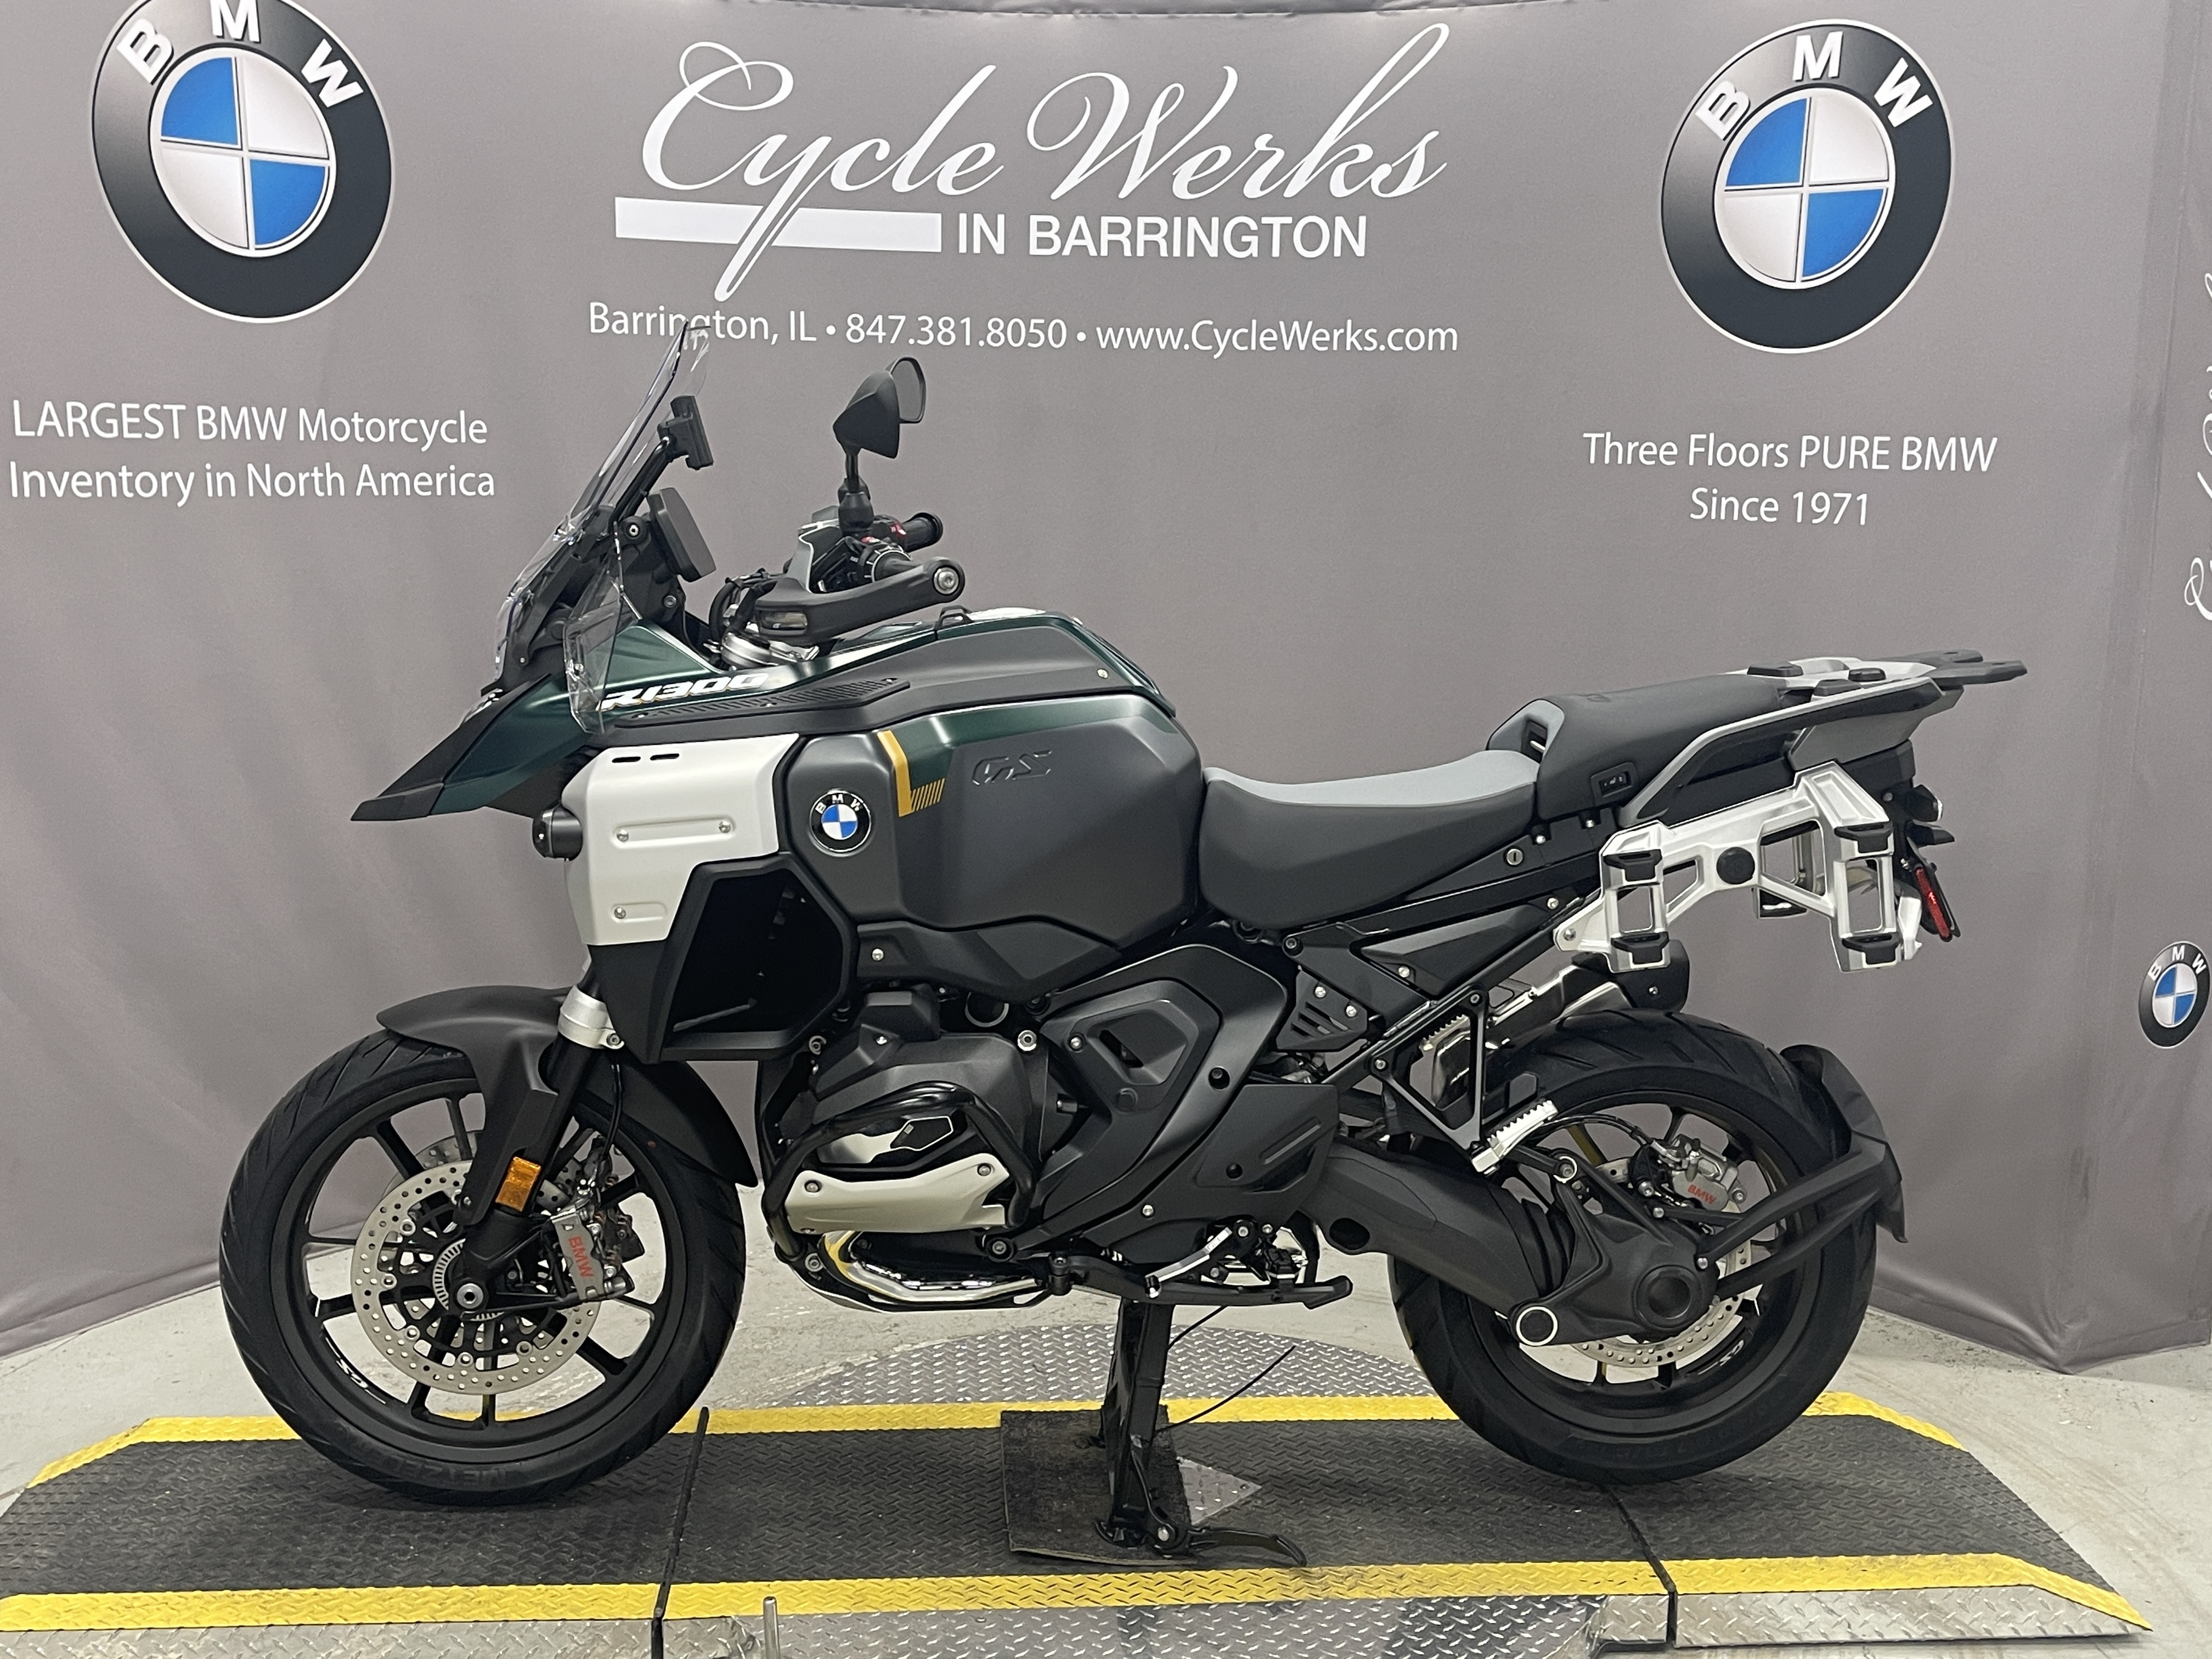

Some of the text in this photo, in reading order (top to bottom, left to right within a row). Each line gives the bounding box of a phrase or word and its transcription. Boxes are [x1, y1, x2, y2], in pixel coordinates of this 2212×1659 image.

[117, 0, 364, 108] BMW
[1695, 31, 1933, 141] BMW
[642, 22, 1450, 302] Cycle Werks
[958, 213, 1367, 258] IN BARRINGTON
[790, 311, 817, 341] IL
[845, 313, 1067, 348] 847.381.8050
[1096, 319, 1458, 359] www.CycleWerks.com
[13, 399, 488, 452] LARGEST BMW Motorcycle
[1583, 431, 1998, 472] Three Floors PURE BMW
[10, 461, 494, 507] Inventory in North America
[1690, 487, 1867, 526] Since 1971
[595, 673, 769, 712] R1300
[972, 749, 1053, 786] GS
[815, 793, 864, 814] BMW
[2147, 944, 2207, 981] BMW
[1687, 1184, 1717, 1205] BMW
[568, 1235, 594, 1277] BMW
